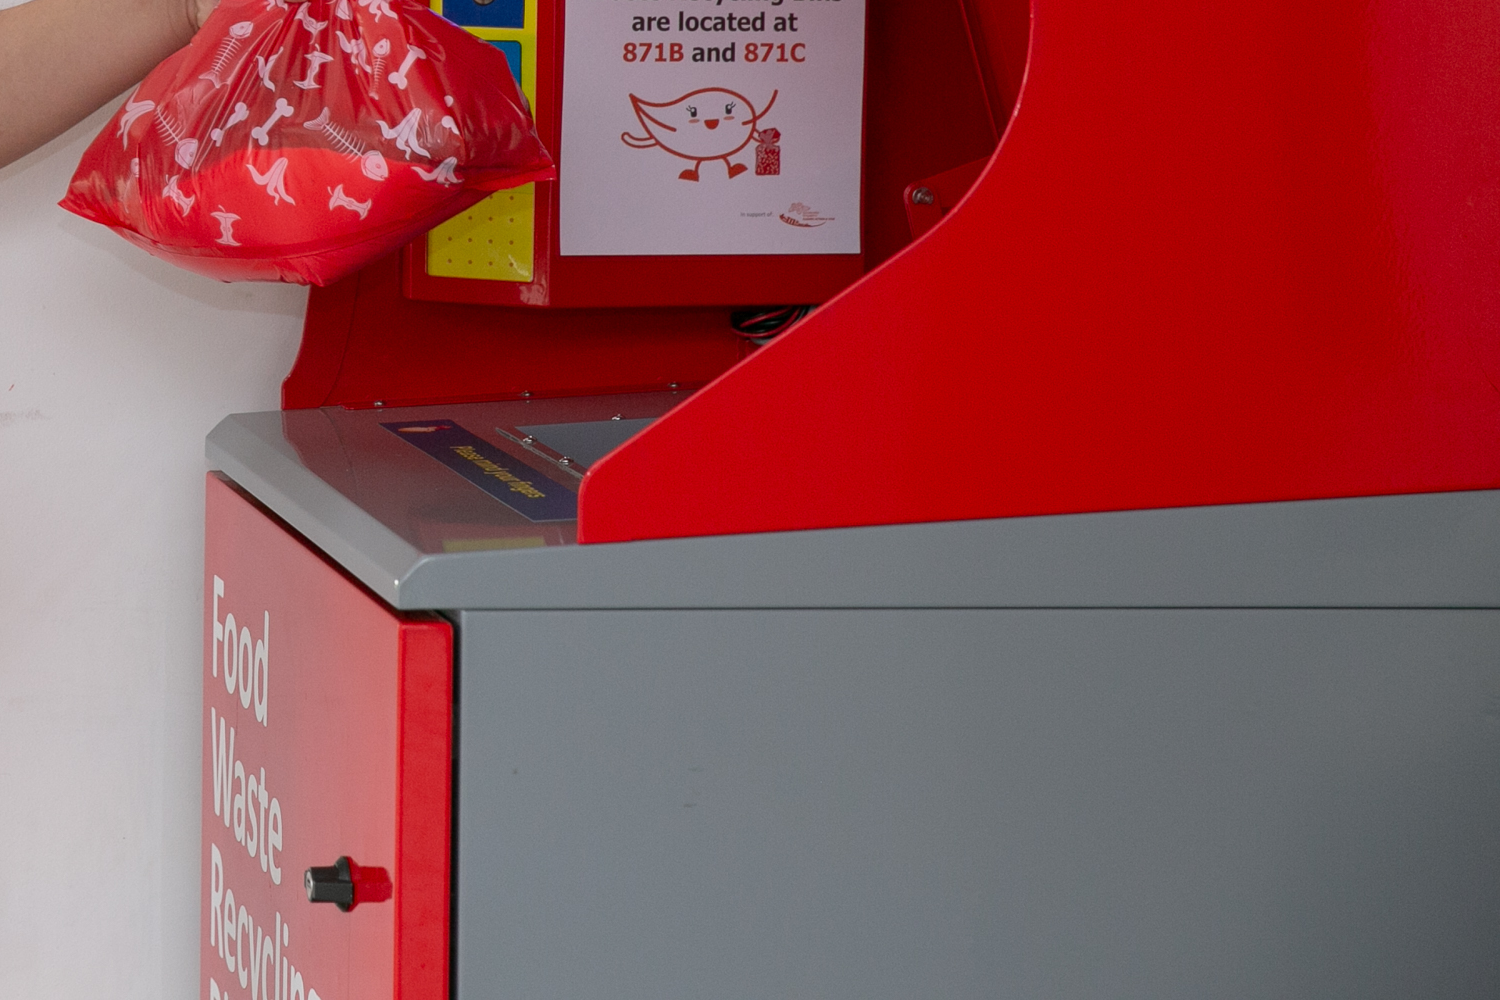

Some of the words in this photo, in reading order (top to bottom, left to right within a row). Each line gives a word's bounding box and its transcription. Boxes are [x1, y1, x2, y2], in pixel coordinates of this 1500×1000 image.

[623, 43, 683, 62] 871B
[692, 42, 735, 62] and
[745, 43, 805, 62] 871C
[632, 16, 670, 31] are
[679, 11, 765, 31] located
[774, 13, 798, 32] at
[211, 575, 269, 727] Food
[211, 707, 282, 885] Waste
